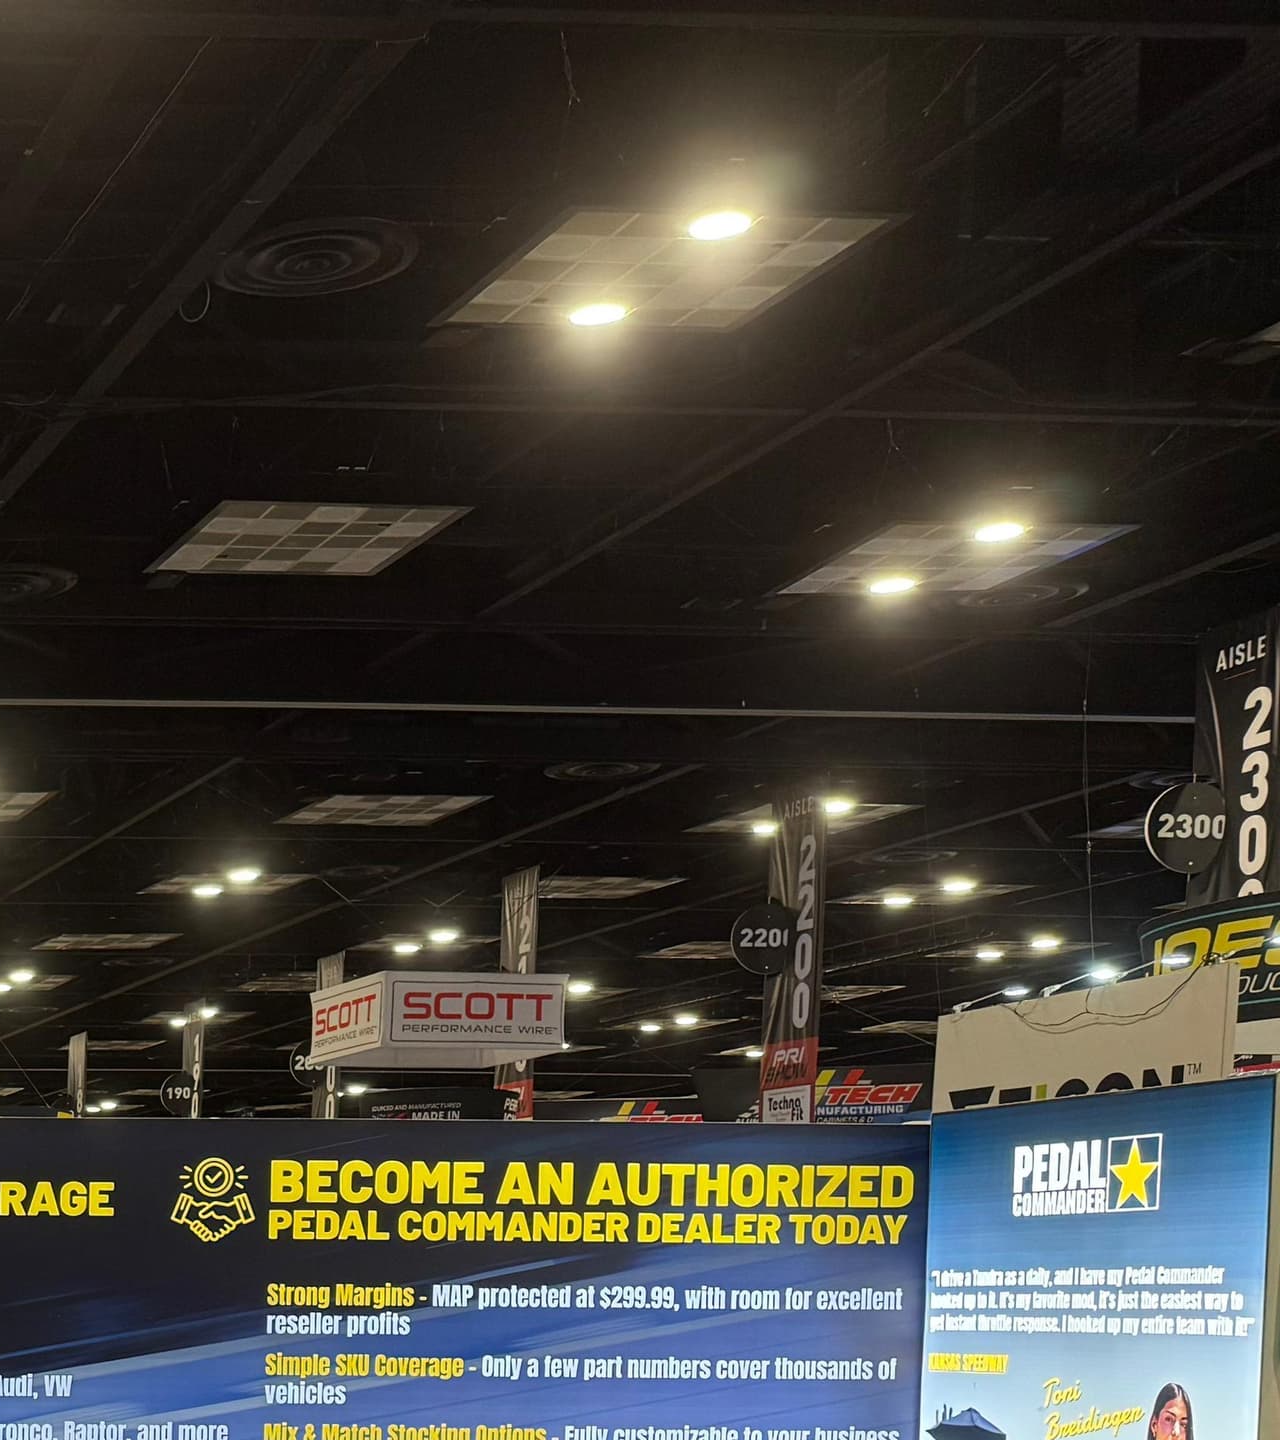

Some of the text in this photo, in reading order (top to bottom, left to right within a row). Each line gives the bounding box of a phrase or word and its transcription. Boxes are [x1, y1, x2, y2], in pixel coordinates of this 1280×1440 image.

[1215, 634, 1267, 674] AISLE
[784, 796, 814, 819] AISLE
[1157, 813, 1226, 840] 2300
[792, 835, 816, 1029] 2200
[315, 994, 377, 1036] SCOTT
[402, 992, 554, 1021] SCOTT
[313, 1030, 357, 1048] PERFORMANCE
[402, 1024, 513, 1034] PERFORMANCE
[772, 1047, 805, 1064] PRI
[825, 1084, 922, 1105] TECH
[1012, 1139, 1107, 1194] PEDAL
[270, 1159, 914, 1209] BECOME AN AUTHORIZED
[1012, 1189, 1106, 1217] COMMANDER
[268, 1209, 909, 1245] PEDAL COMMANDER DEALER TODAY
[1157, 1265, 1225, 1286] Commander
[266, 1282, 903, 1312] Strong Margins protected $299.99, excellent
[1204, 1293, 1228, 1312] way
[347, 1311, 411, 1338] profits
[265, 1352, 331, 1378] Simple
[1043, 1377, 1082, 1408] Toni
